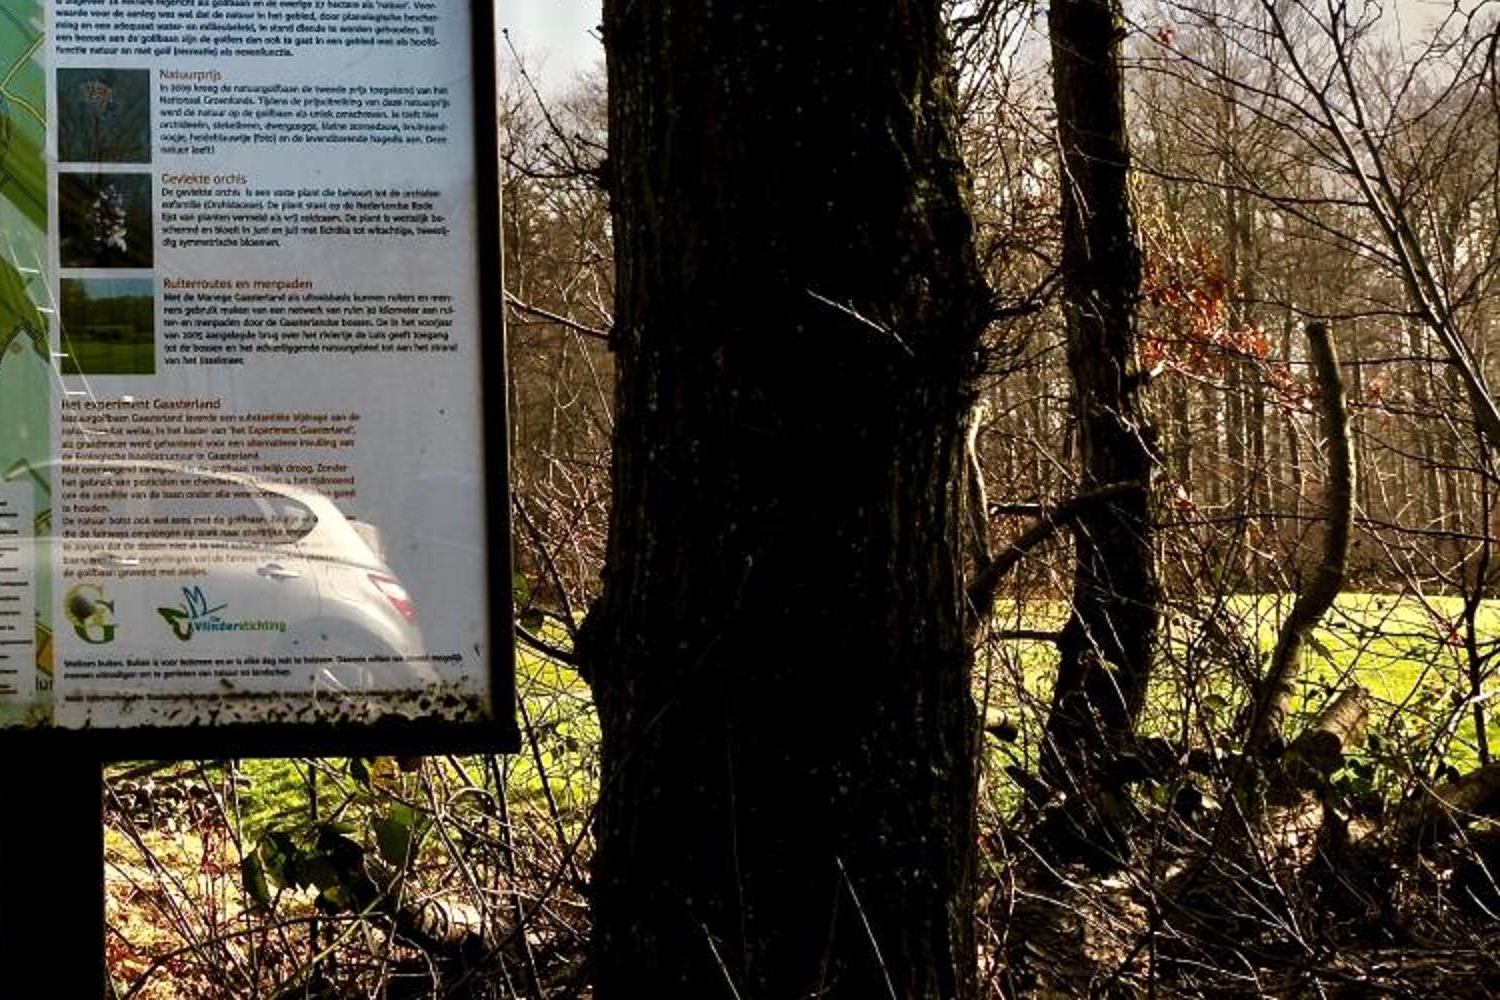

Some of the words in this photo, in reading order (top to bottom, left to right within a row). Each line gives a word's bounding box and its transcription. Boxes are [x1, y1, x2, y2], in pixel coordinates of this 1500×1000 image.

[159, 69, 222, 82] Natuurprijs
[161, 173, 211, 184] Gevlekte
[213, 173, 247, 184] orchis
[163, 277, 232, 289] Ruiterroutes
[235, 280, 250, 289] en
[253, 276, 313, 290] menpaden
[84, 400, 150, 412] experiment
[153, 398, 221, 409] Gaasterland
[194, 620, 287, 633] Vlinderstichting
